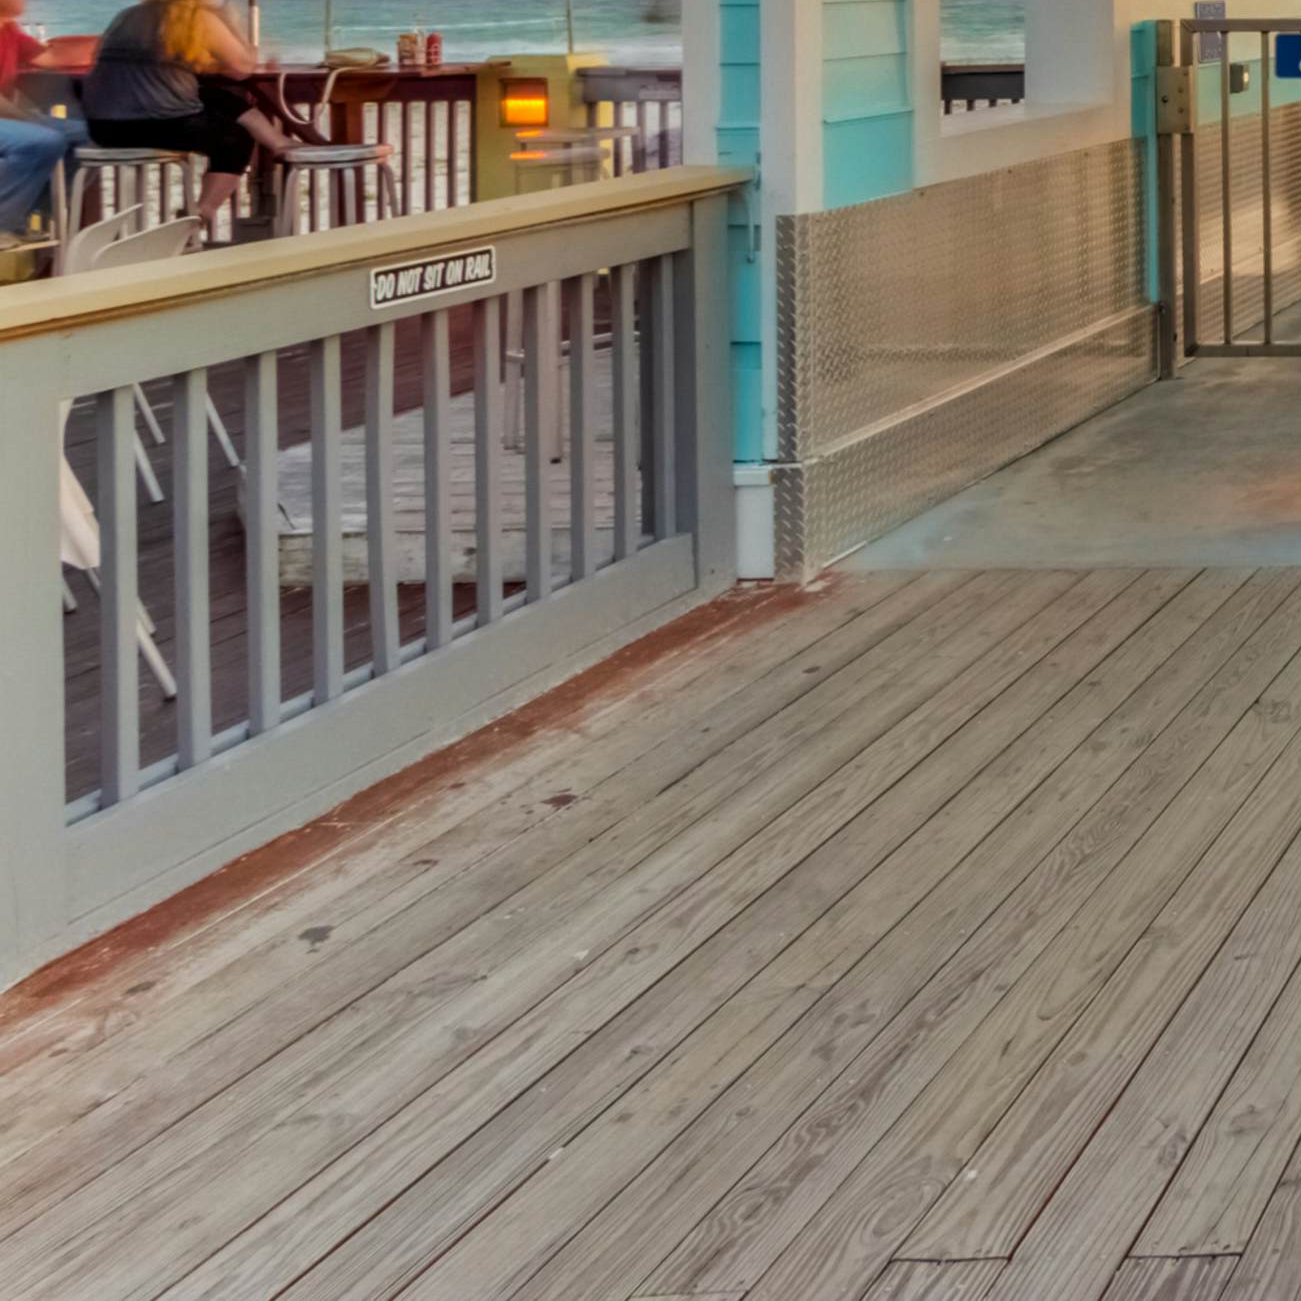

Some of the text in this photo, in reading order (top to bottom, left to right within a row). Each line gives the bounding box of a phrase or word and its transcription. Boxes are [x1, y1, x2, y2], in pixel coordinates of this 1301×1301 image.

[376, 253, 491, 301] DO NOT SIT ON RAIL
